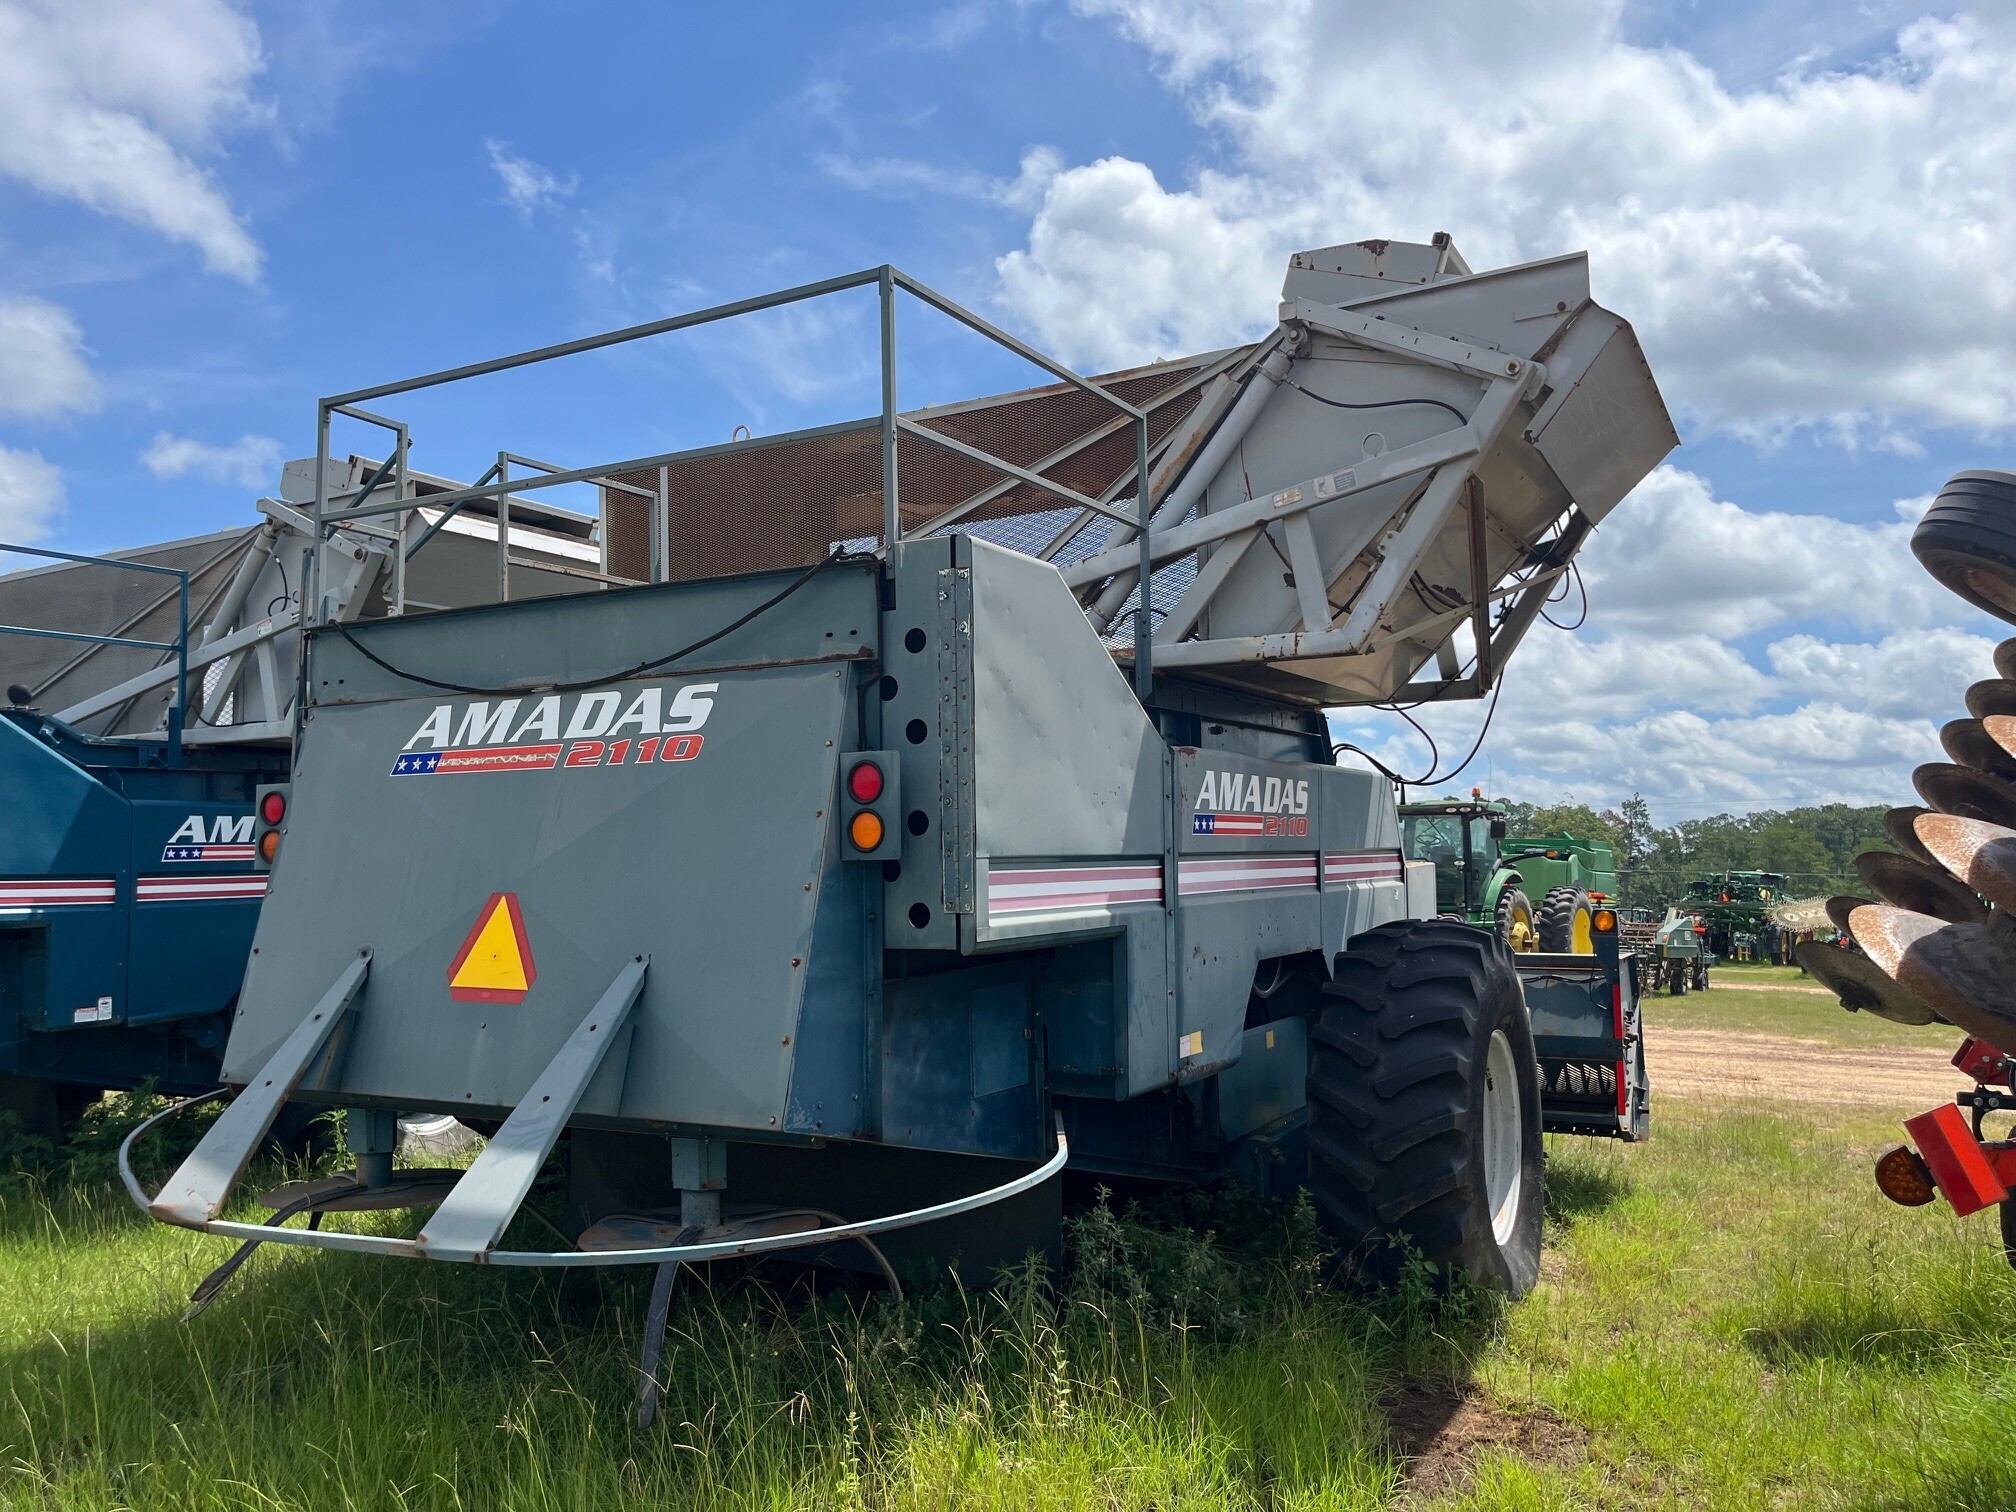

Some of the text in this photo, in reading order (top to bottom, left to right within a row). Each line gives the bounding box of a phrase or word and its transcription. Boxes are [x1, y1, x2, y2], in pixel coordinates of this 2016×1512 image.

[402, 682, 719, 750] AMADAS
[563, 734, 705, 768] 2110
[1194, 770, 1309, 815] AMADAS
[167, 815, 256, 843] AM
[1264, 815, 1309, 837] 2110
